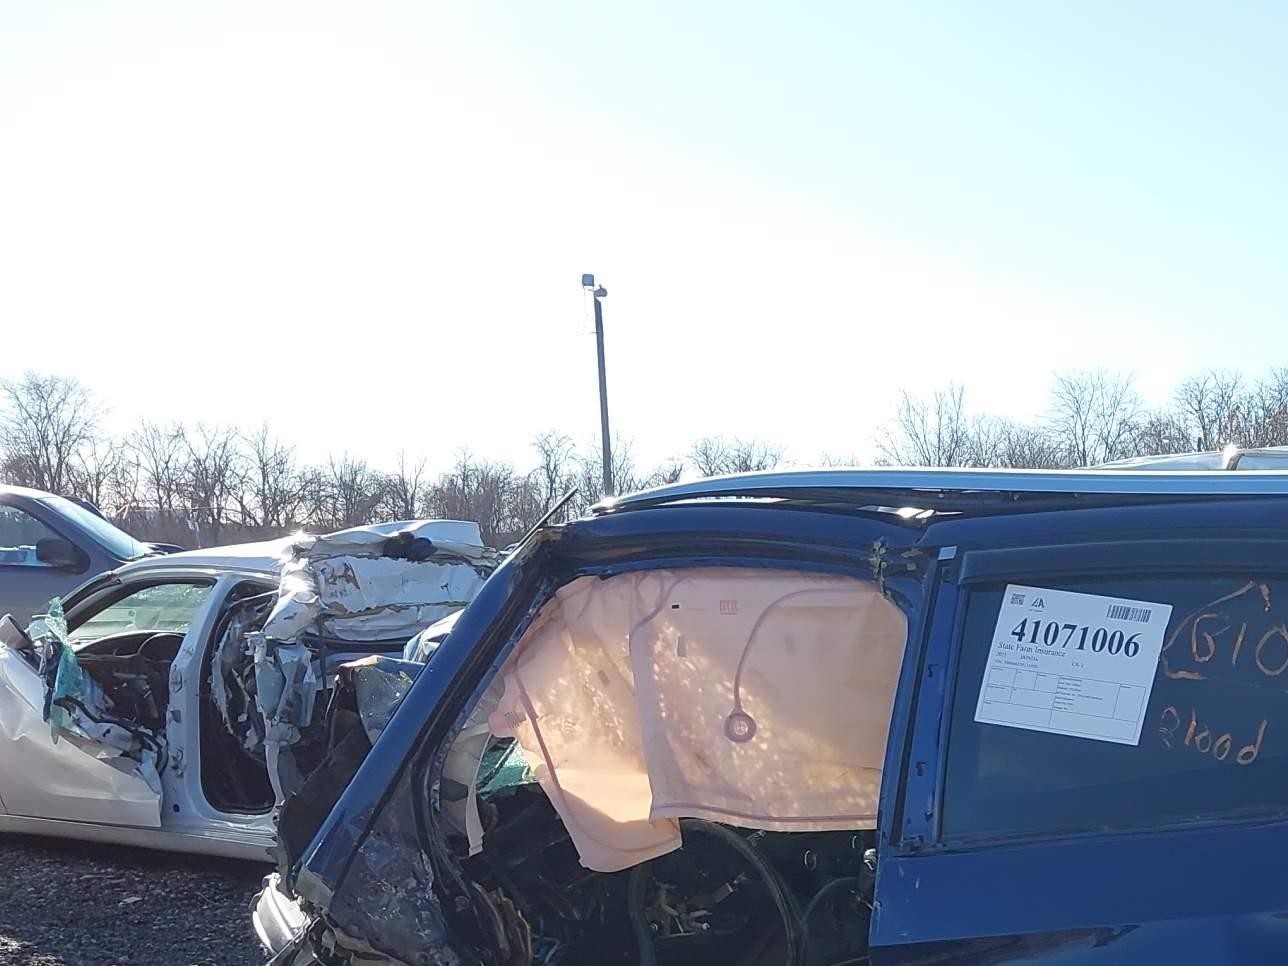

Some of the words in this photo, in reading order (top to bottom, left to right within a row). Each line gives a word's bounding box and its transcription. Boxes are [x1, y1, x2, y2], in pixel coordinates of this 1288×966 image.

[998, 641, 1015, 651] State
[1015, 643, 1034, 654] Farm
[1035, 646, 1066, 658] Insurance
[1011, 617, 1143, 657] 41071006
